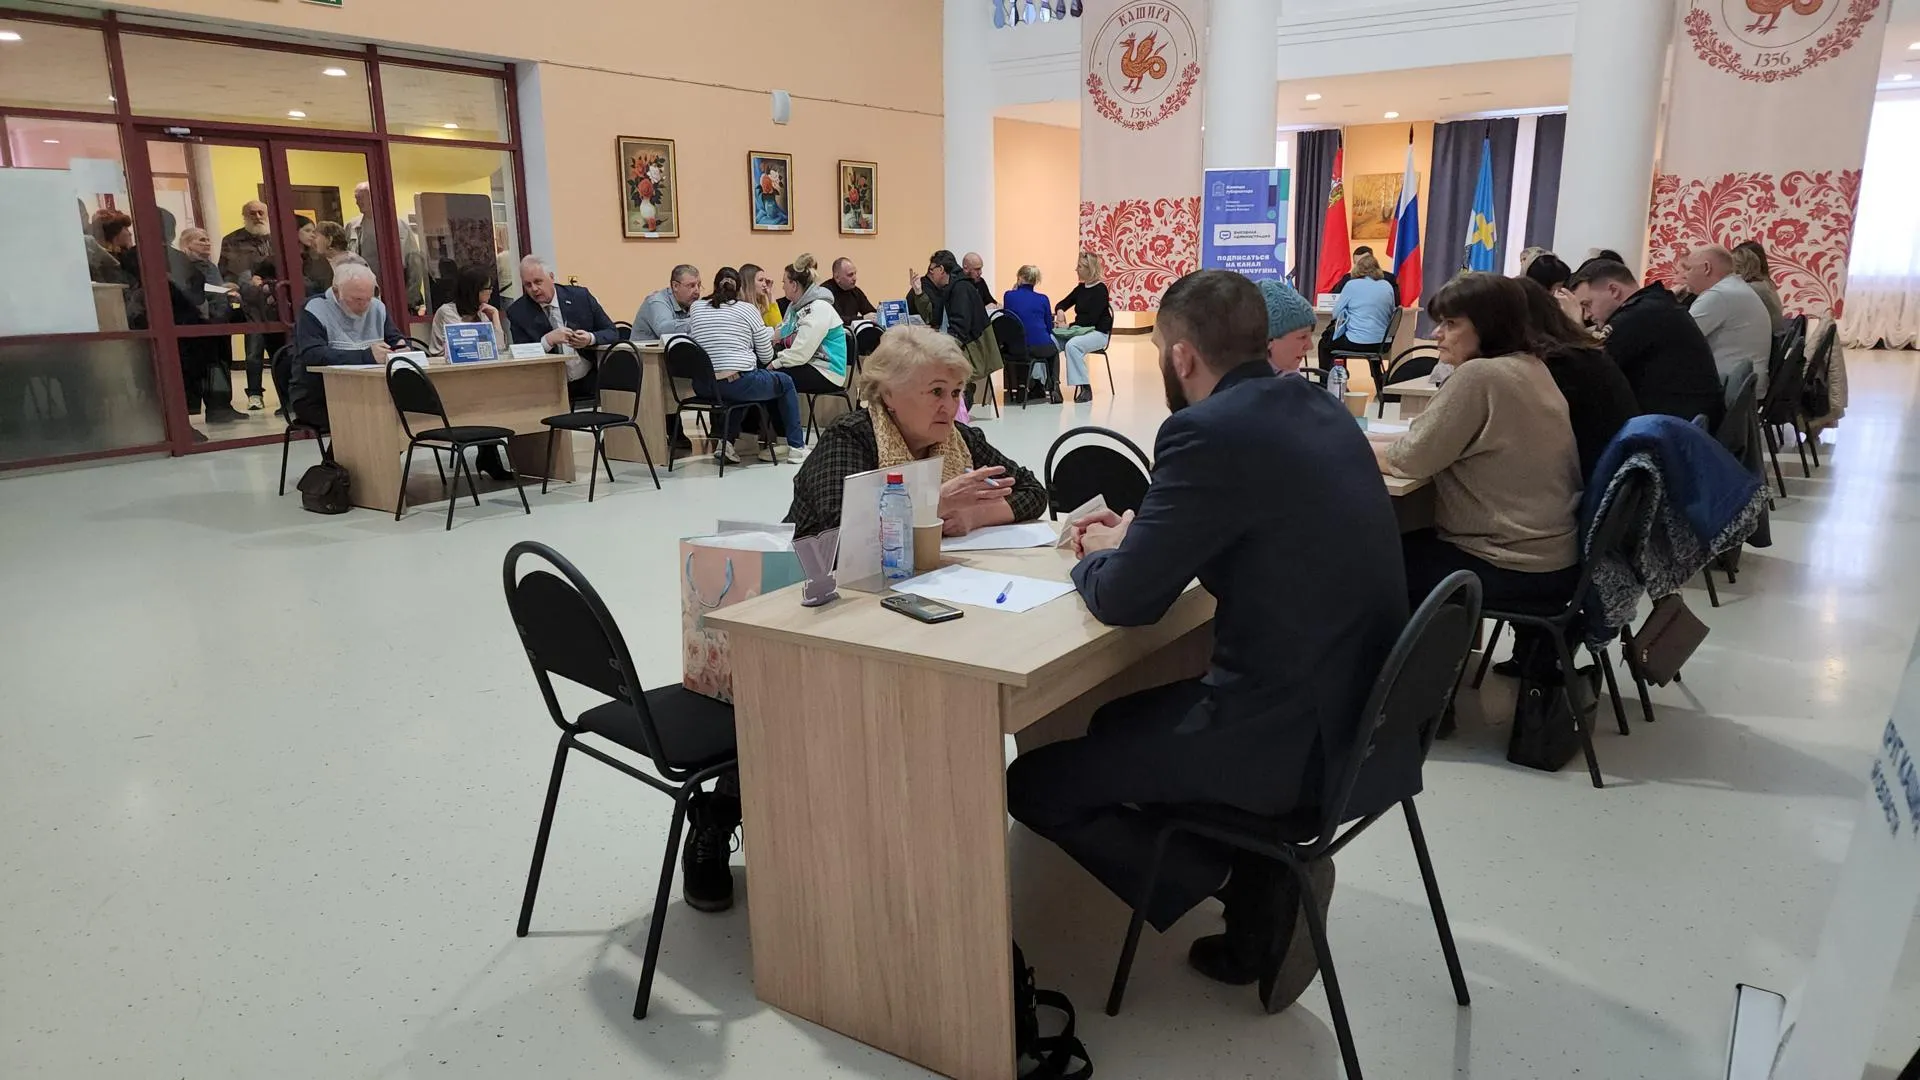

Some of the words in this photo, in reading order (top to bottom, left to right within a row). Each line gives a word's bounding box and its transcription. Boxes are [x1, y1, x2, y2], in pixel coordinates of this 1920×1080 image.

[1118, 6, 1170, 26] КАШИРА
[1754, 51, 1791, 67] 1356
[1130, 106, 1152, 119] 1356
